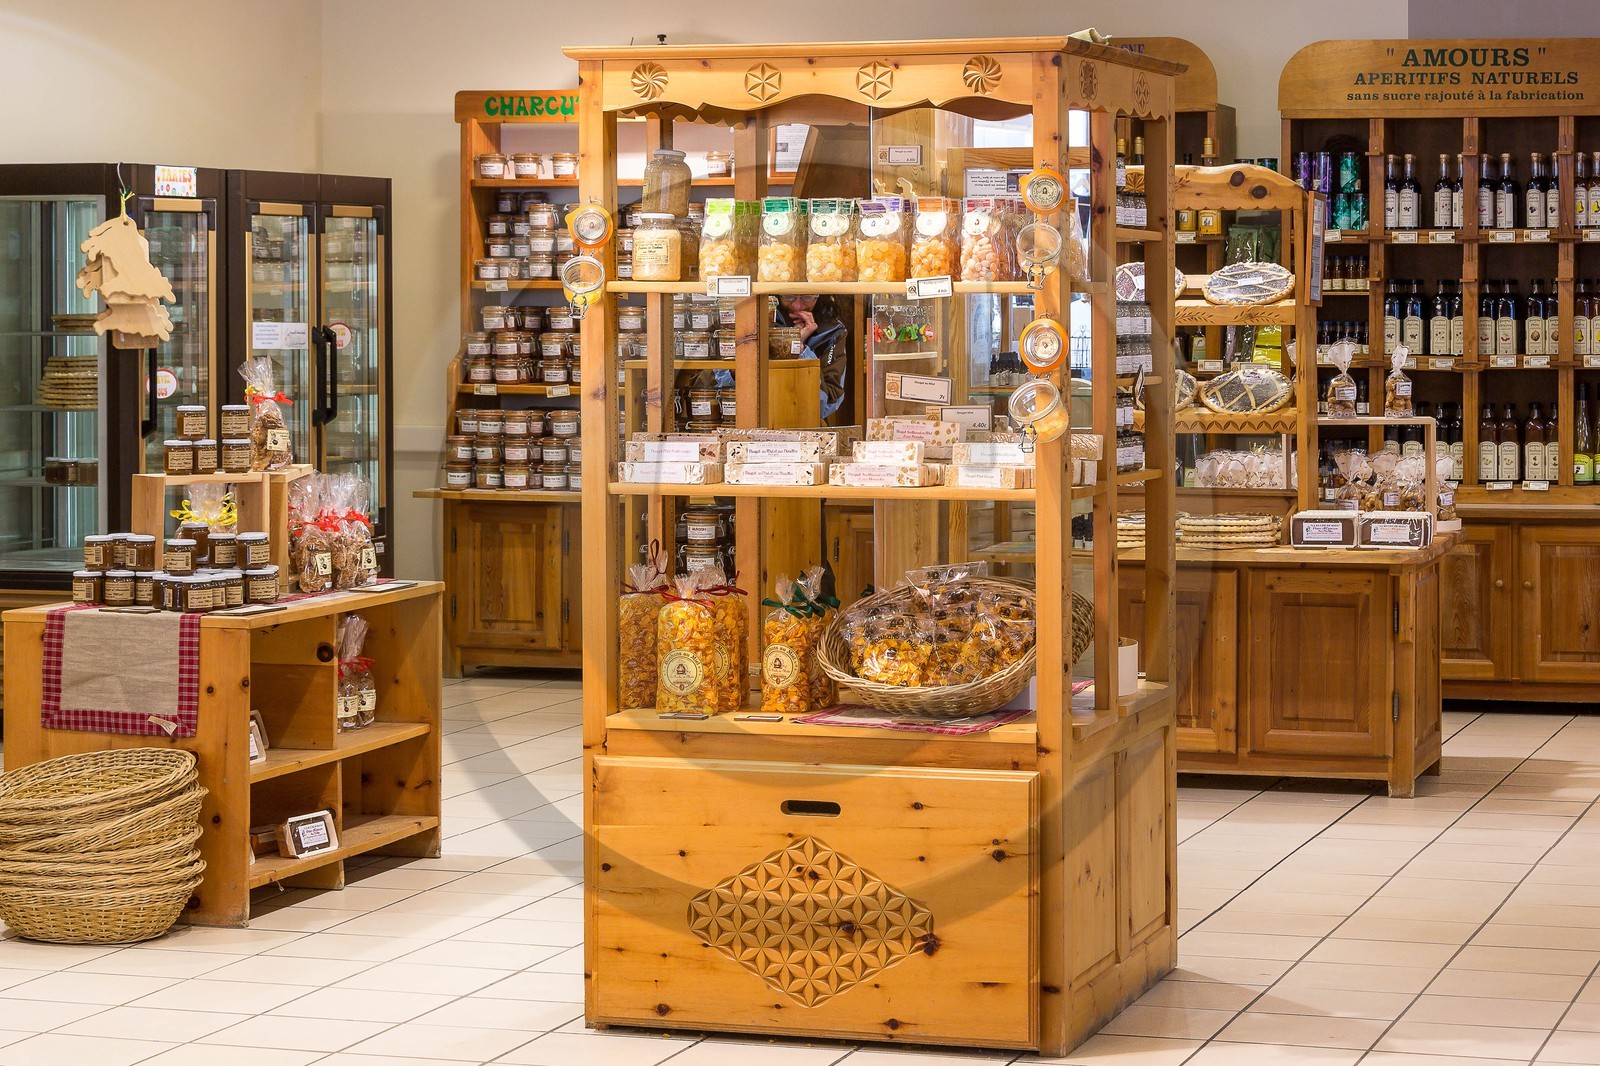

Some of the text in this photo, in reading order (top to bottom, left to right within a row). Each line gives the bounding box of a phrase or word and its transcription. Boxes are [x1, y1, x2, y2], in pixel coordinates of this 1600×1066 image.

[1402, 48, 1530, 67] AMOURS
[1354, 71, 1579, 86] APERITIFS NATURELS
[1346, 89, 1585, 103] sans sucre rajouté à la fabrication
[484, 96, 579, 117] CHARCU
[160, 168, 193, 184] TARTES
